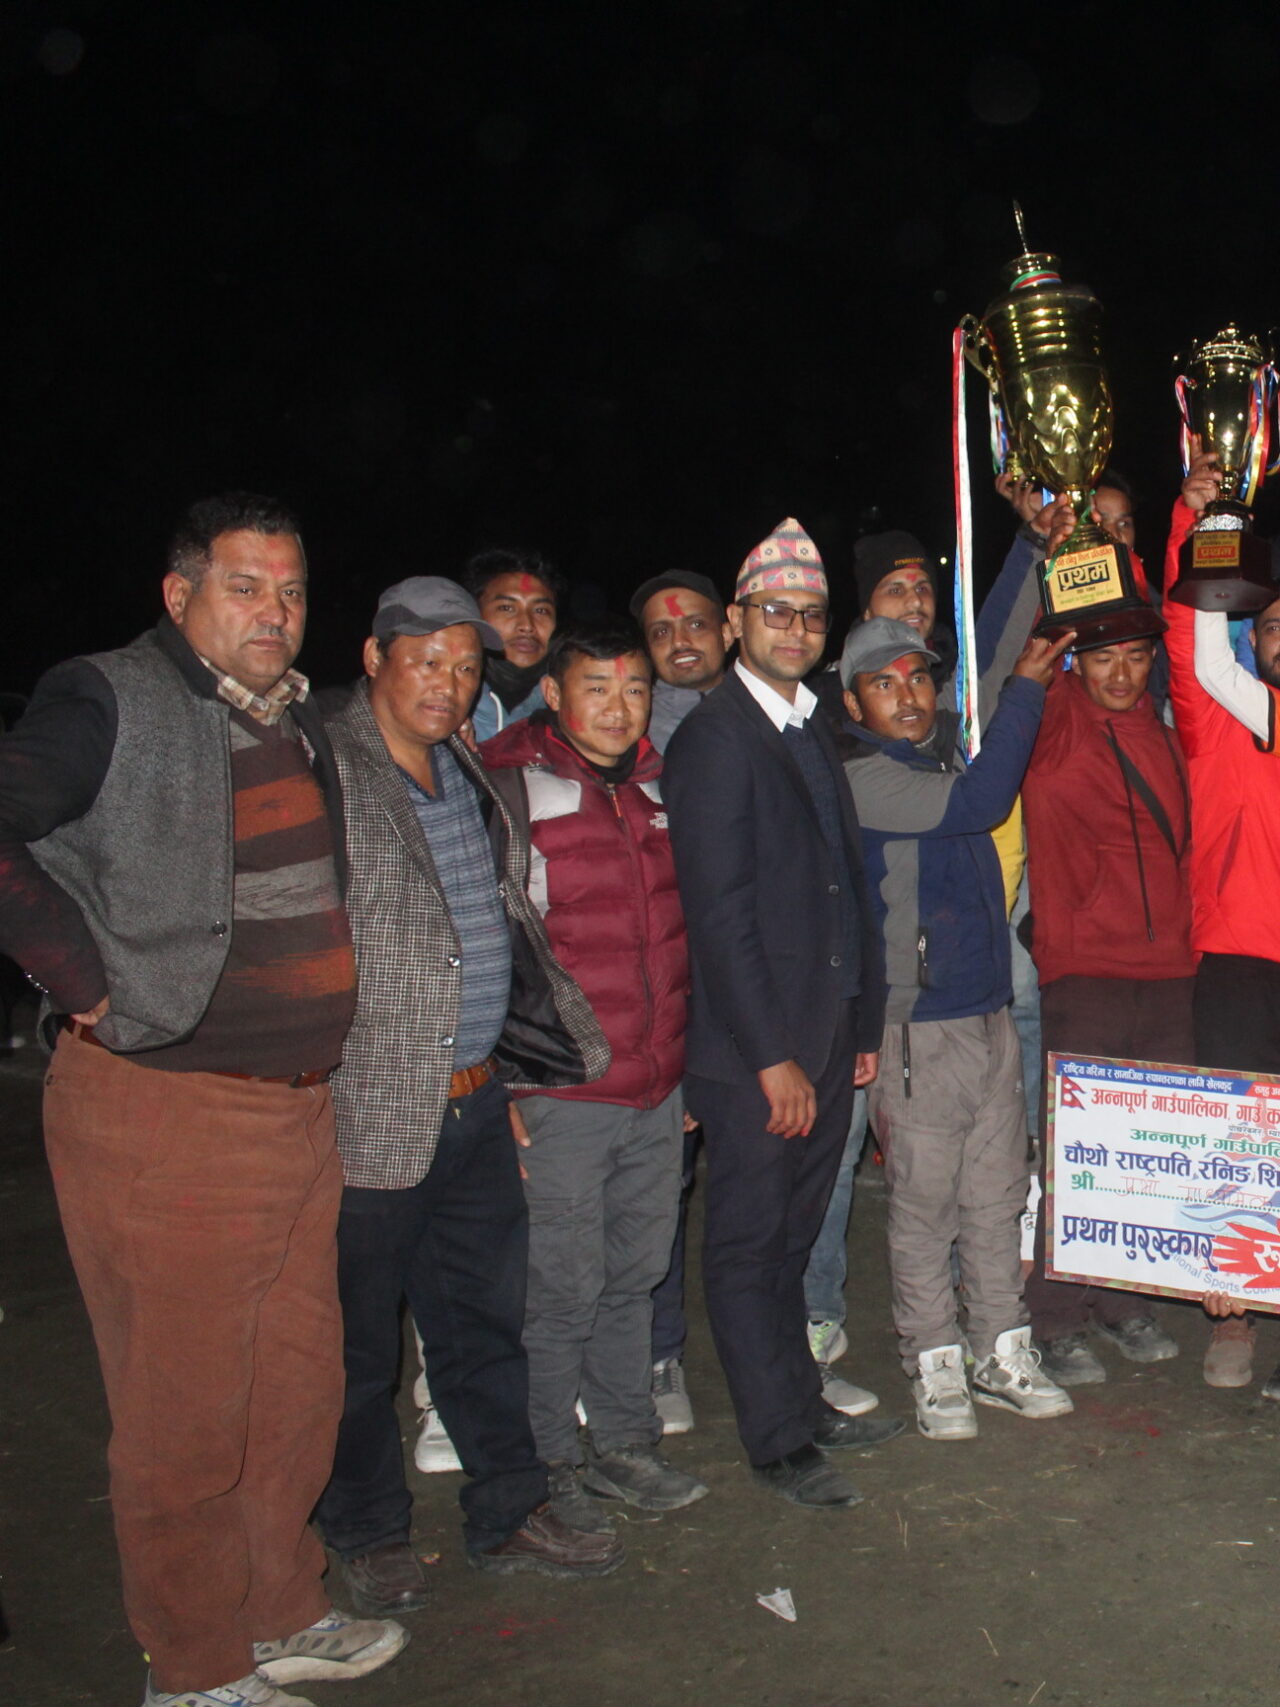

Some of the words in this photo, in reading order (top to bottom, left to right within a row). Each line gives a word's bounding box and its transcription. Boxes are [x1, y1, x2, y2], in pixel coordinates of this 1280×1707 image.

[1058, 562, 1109, 591] प्रथम
[1107, 1068, 1113, 1078] र
[1114, 1068, 1144, 1081] सामाजिक
[1091, 1087, 1148, 1114] अन्नपूर्ण
[1129, 1128, 1207, 1150] अन्नपूर्ण
[1063, 1139, 1109, 1167] चौथो
[1115, 1151, 1192, 1178] राष्ट्रपति
[1198, 1157, 1251, 1183] रनिङ
[1071, 1170, 1096, 1191] श्री
[1060, 1215, 1119, 1246] प्रथम
[1121, 1222, 1219, 1273] पुरस्कार
[1203, 1271, 1241, 1293] Sports
